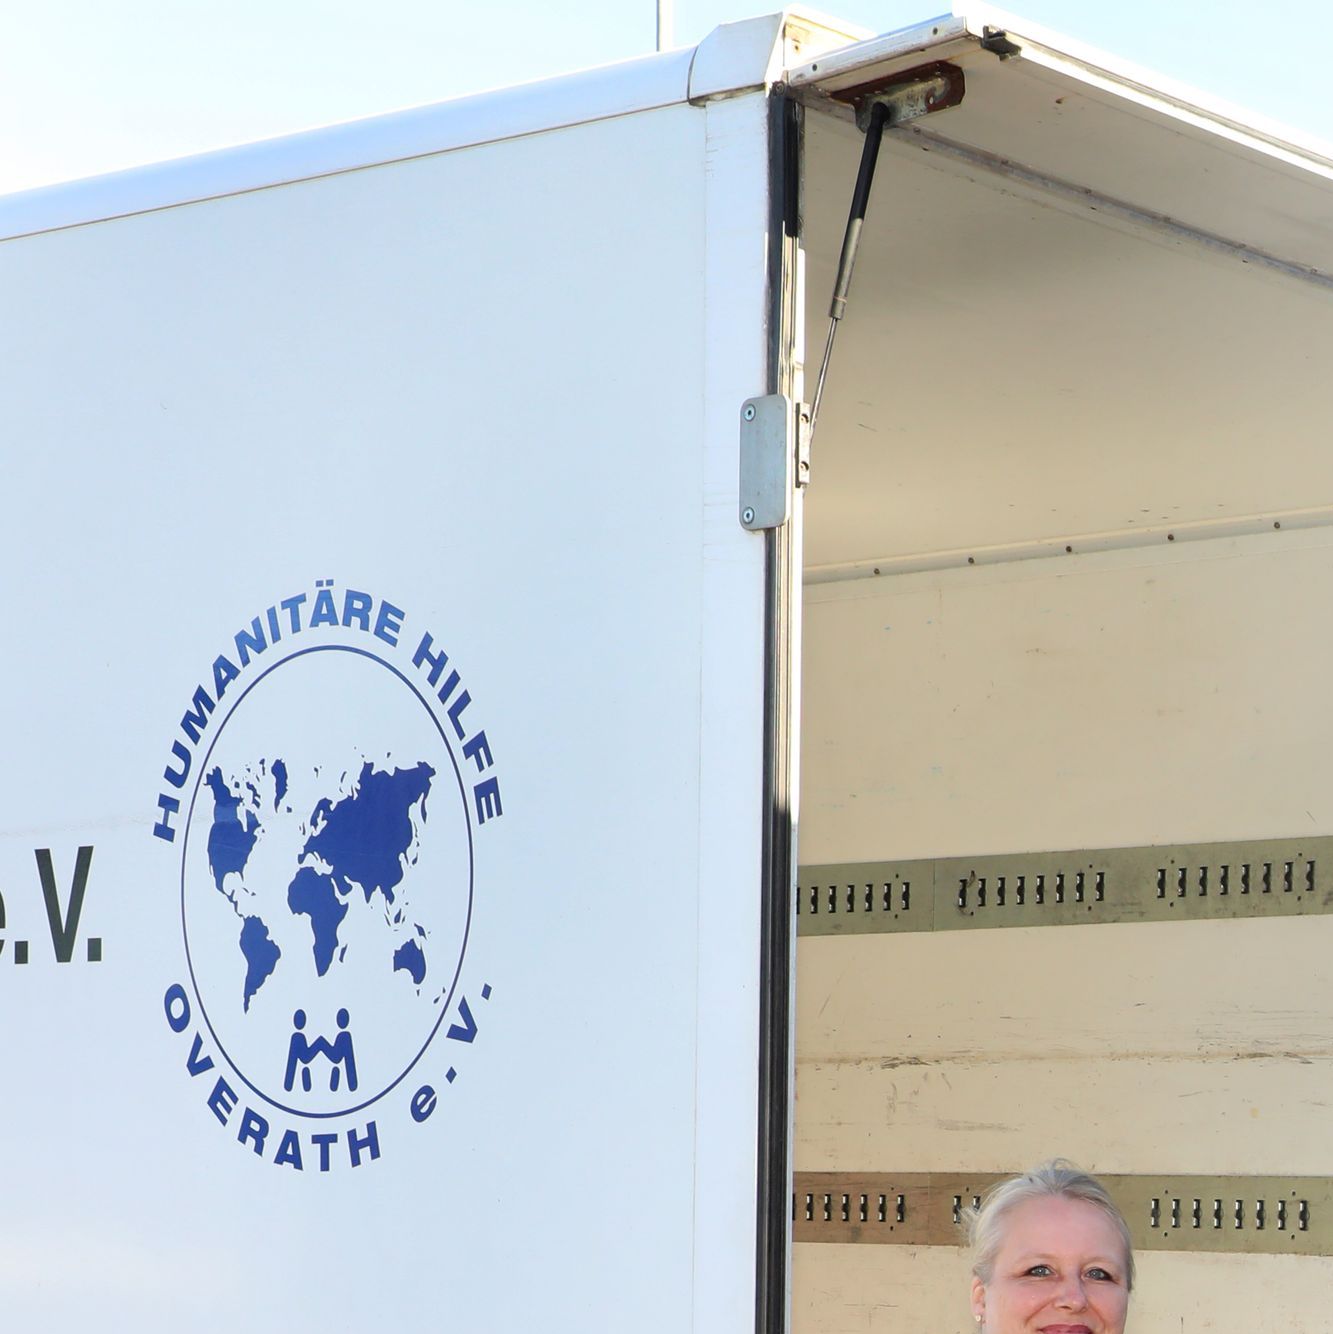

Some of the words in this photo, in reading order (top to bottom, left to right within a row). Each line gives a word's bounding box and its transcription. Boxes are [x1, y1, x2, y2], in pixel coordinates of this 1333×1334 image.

[153, 578, 406, 843] HUMANITÄRE
[411, 631, 503, 825] HILFE
[0, 845, 102, 965] .V.
[164, 983, 381, 1172] OVERATH
